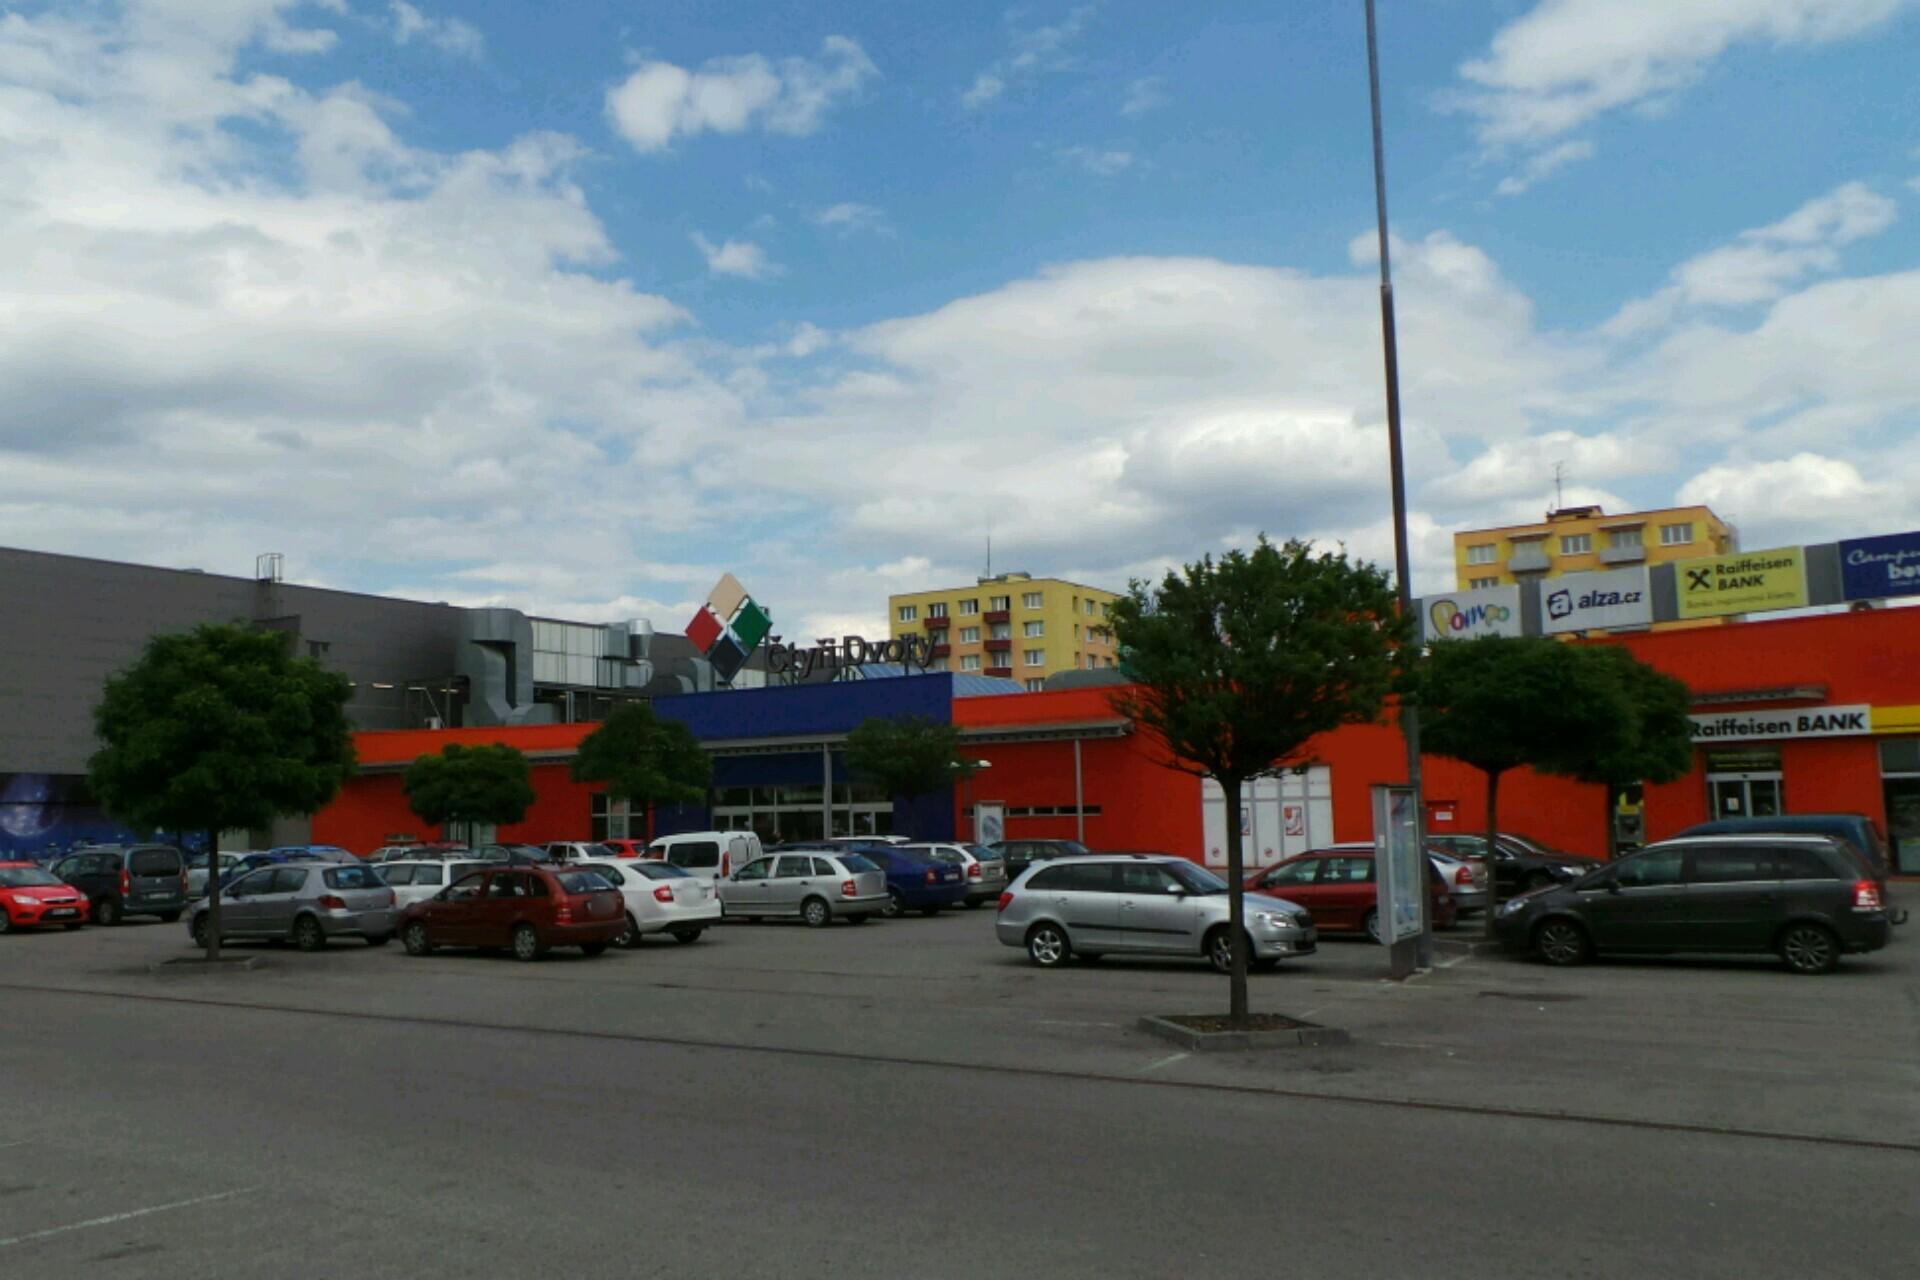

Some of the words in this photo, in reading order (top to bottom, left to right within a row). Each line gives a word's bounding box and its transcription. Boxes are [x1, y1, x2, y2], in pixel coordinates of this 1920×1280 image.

[1716, 558, 1793, 575] Raiffeisen
[1718, 574, 1764, 591] BANK
[1578, 590, 1642, 610] alza.cz
[843, 634, 937, 668] Dvory
[1690, 718, 1792, 738] Raiffeisen
[1797, 712, 1864, 732] BANK
